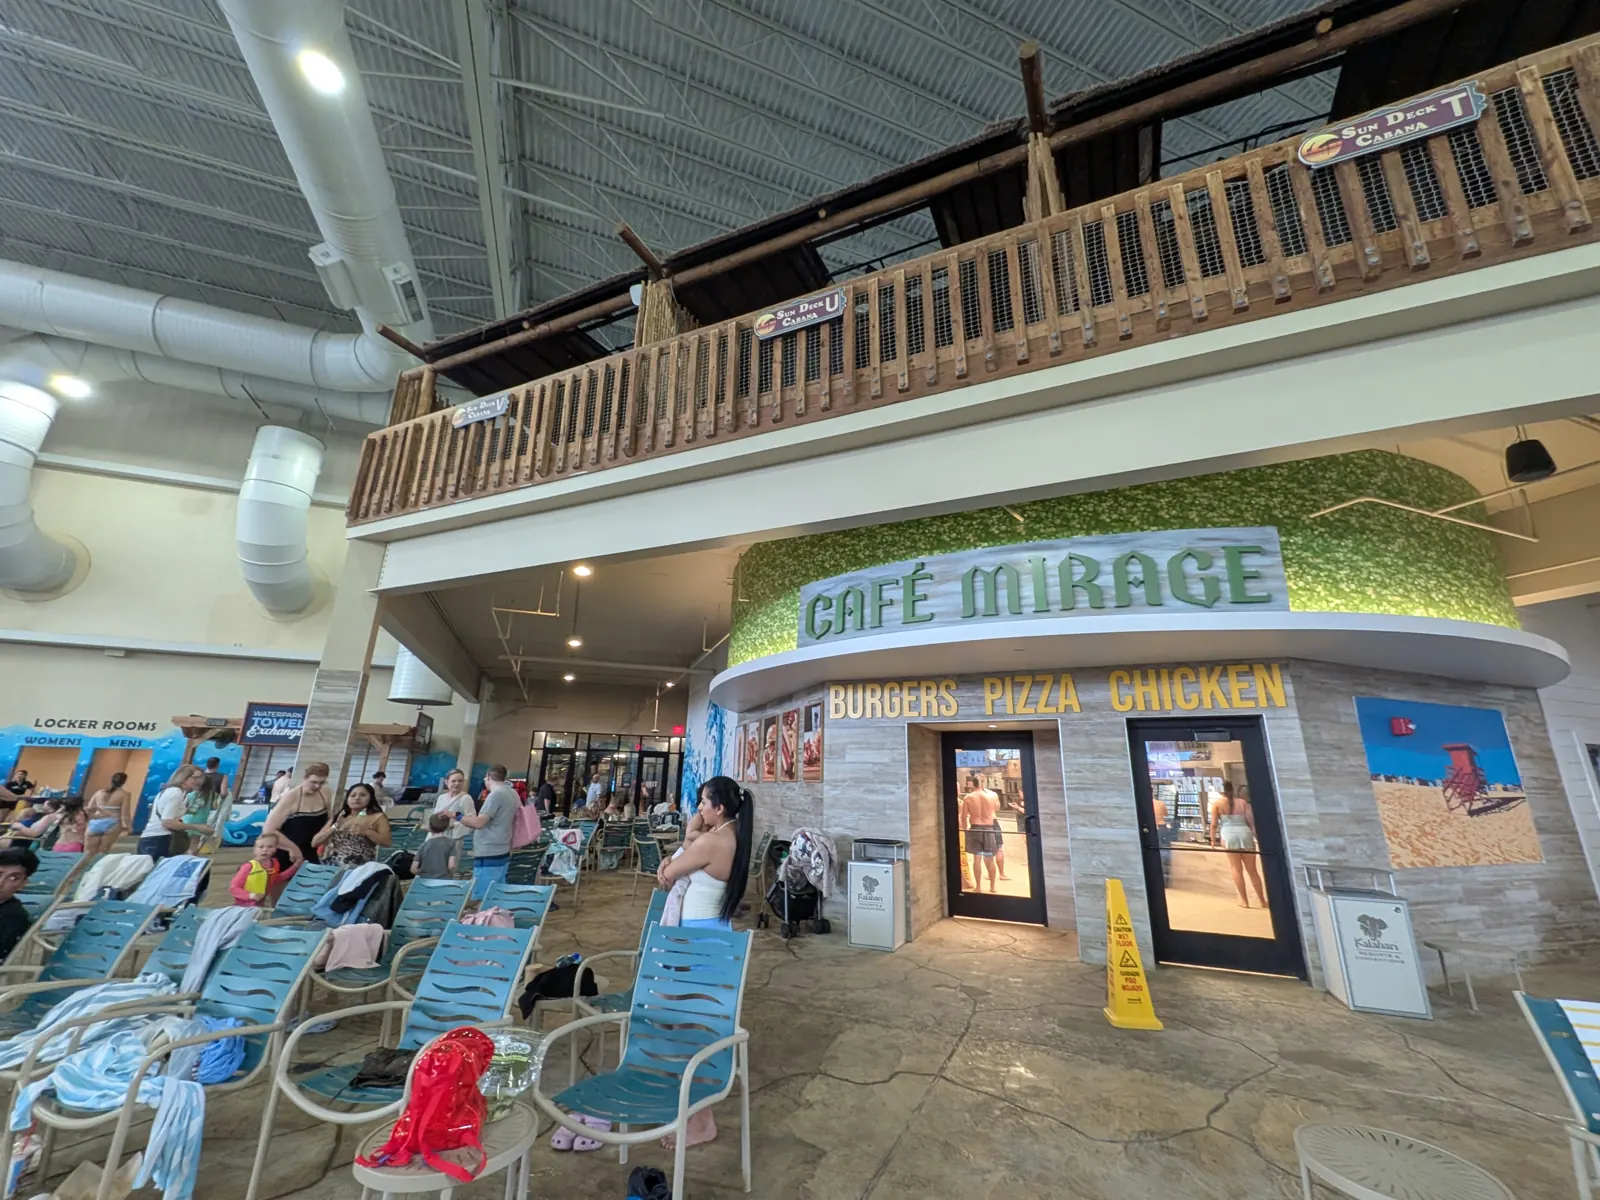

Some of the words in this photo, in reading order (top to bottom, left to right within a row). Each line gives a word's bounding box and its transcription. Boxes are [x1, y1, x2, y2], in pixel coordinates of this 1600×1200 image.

[1440, 92, 1467, 117] T
[825, 294, 839, 312] U
[496, 397, 505, 411] V
[805, 561, 935, 640] CAFÉ
[961, 545, 1274, 619] MIRAGE
[829, 678, 959, 720] BURGERS
[984, 673, 1082, 716] PIZZA
[1108, 662, 1289, 713] CHICKEN
[253, 710, 304, 719] WATERPARK
[34, 718, 98, 730] LOCKER
[102, 720, 157, 731] ROOMS
[251, 717, 305, 729] TOWEL
[246, 725, 304, 740] Exchange
[24, 736, 82, 746] WOMENS
[109, 739, 142, 748] MENS
[1174, 776, 1224, 793] ENTER
